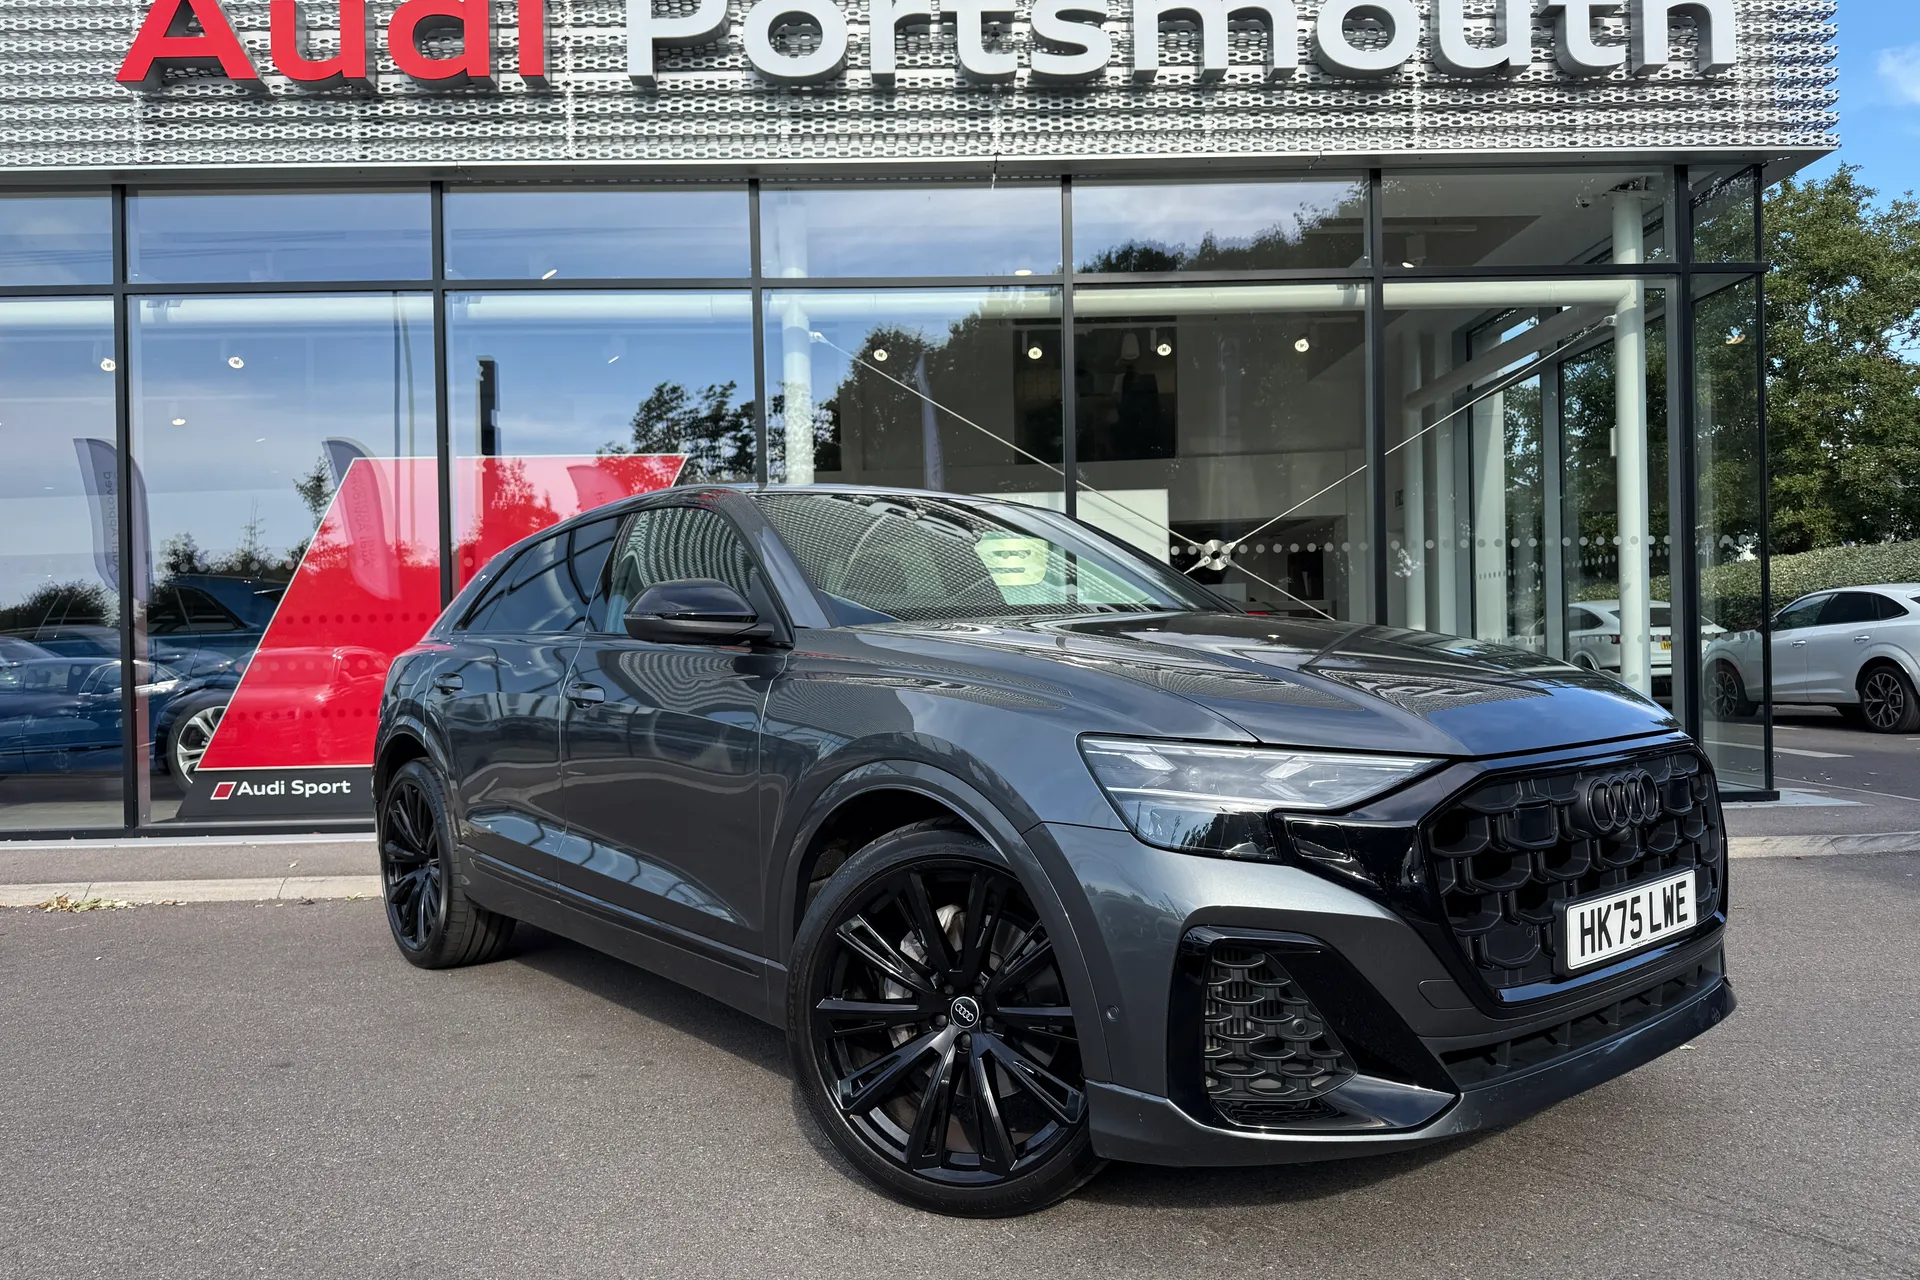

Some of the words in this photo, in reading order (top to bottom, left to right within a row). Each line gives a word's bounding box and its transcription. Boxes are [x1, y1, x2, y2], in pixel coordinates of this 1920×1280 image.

[115, 0, 548, 85] Audi
[628, 0, 1737, 82] Portsmouth
[236, 780, 285, 797] Audi
[291, 779, 351, 798] Sport
[1579, 895, 1643, 957] HK75
[1648, 880, 1688, 934] LWE
